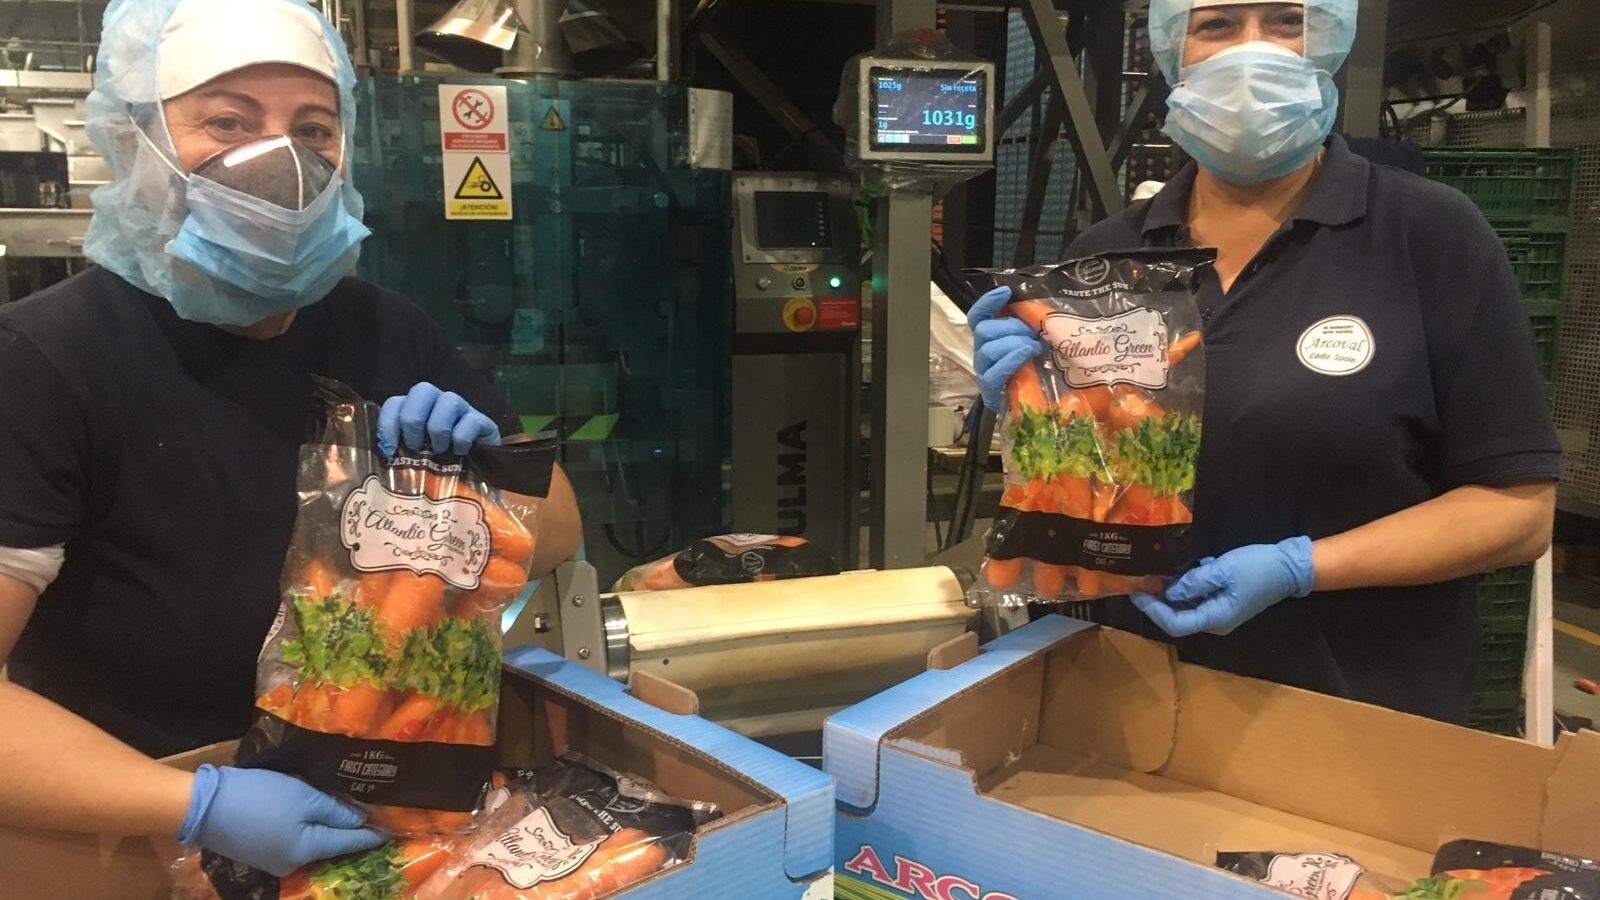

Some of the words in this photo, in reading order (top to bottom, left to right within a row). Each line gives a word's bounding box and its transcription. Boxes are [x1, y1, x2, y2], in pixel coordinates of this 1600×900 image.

[879, 81, 902, 90] 1025g
[954, 84, 977, 92] receta
[922, 110, 976, 130] 1031g
[1061, 288, 1092, 297] TASTE
[1058, 339, 1111, 359] Atlantic
[1113, 334, 1153, 362] Green
[386, 457, 420, 466] TASTE
[441, 464, 463, 473] SUN
[776, 420, 807, 536] ULMA
[364, 507, 425, 540] Atlantic
[427, 521, 465, 551] Green
